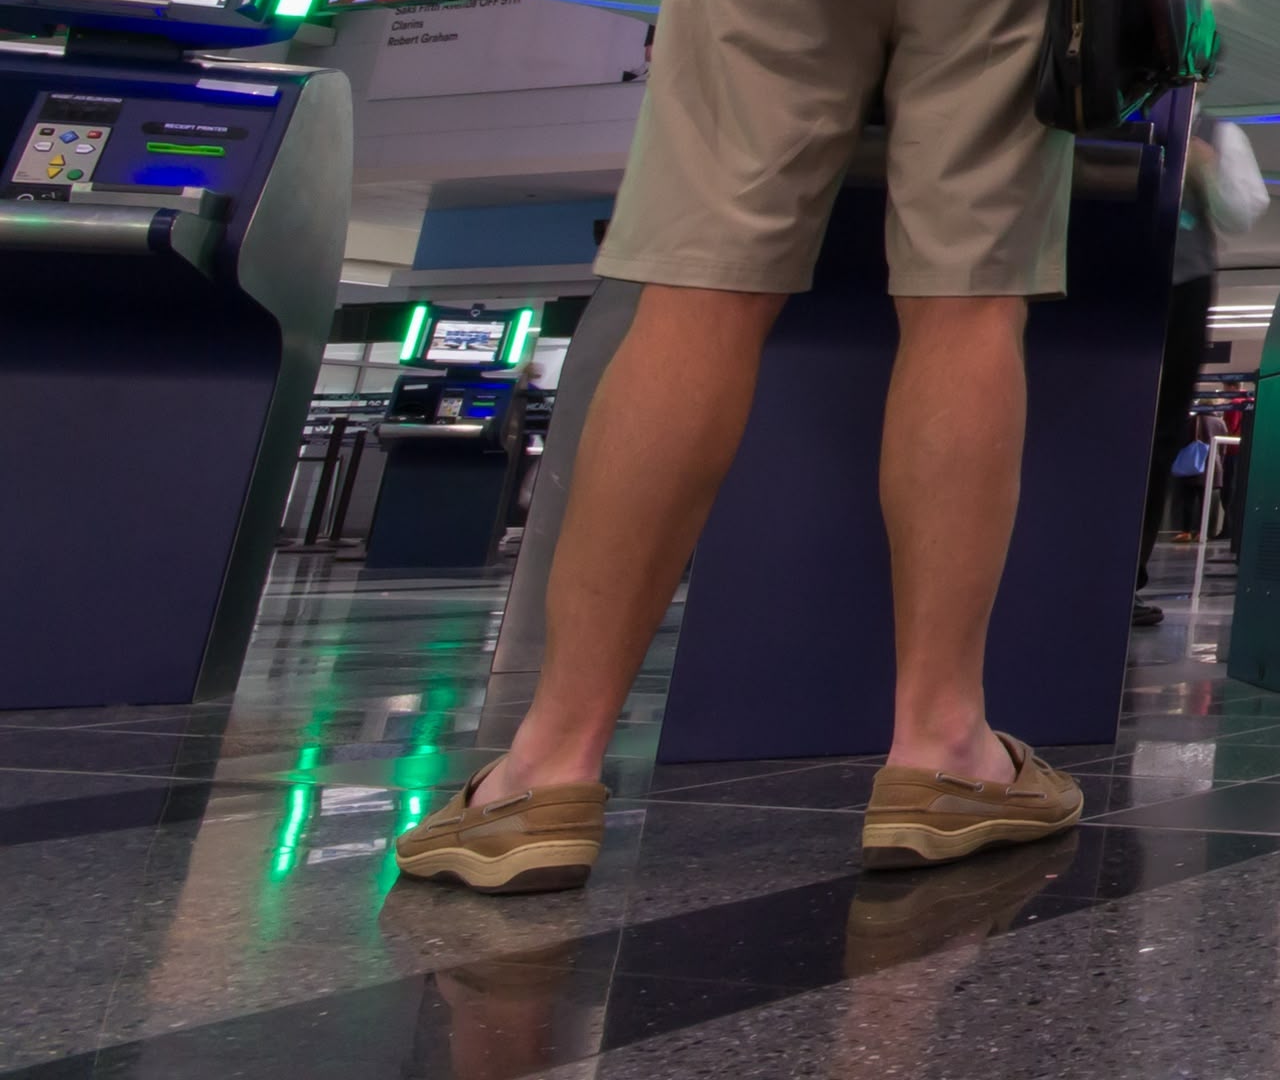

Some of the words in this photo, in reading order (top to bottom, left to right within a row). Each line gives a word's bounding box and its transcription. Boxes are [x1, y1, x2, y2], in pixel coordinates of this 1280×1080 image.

[391, 19, 424, 31] Clarins
[387, 33, 419, 47] Robert
[420, 31, 459, 44] Graham
[164, 122, 195, 131] RECEIPT
[197, 124, 228, 133] PRINTER
